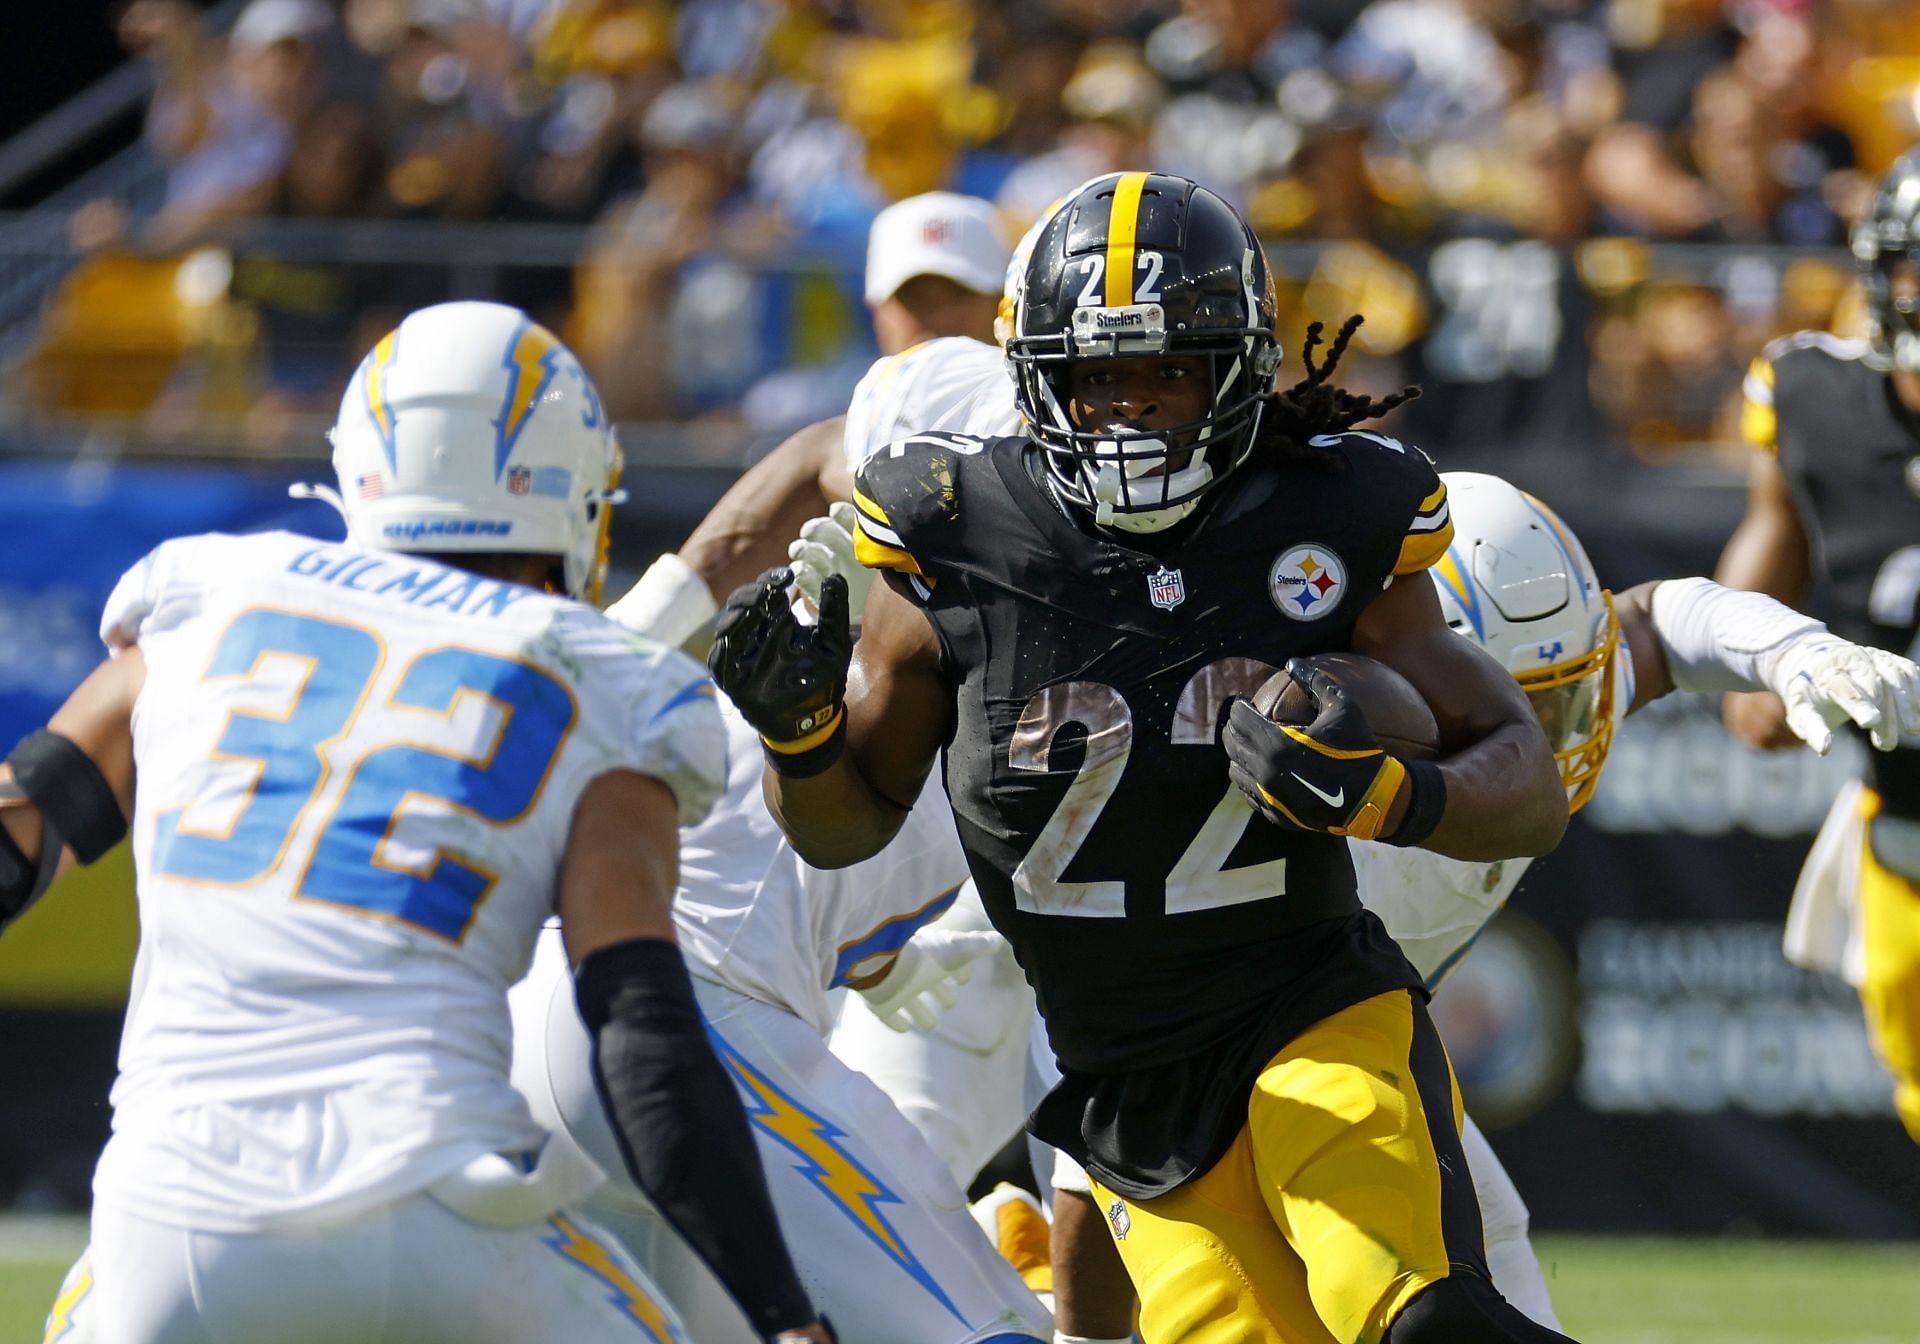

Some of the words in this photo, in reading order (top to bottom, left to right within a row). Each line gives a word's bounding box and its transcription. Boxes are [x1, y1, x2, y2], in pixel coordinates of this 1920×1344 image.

[1096, 311, 1142, 328] Steelers
[285, 547, 535, 617] GILMAN
[1154, 585, 1181, 603] NFL
[1277, 574, 1307, 586] Steelers
[150, 602, 579, 948] 32
[1008, 656, 1287, 918] 22
